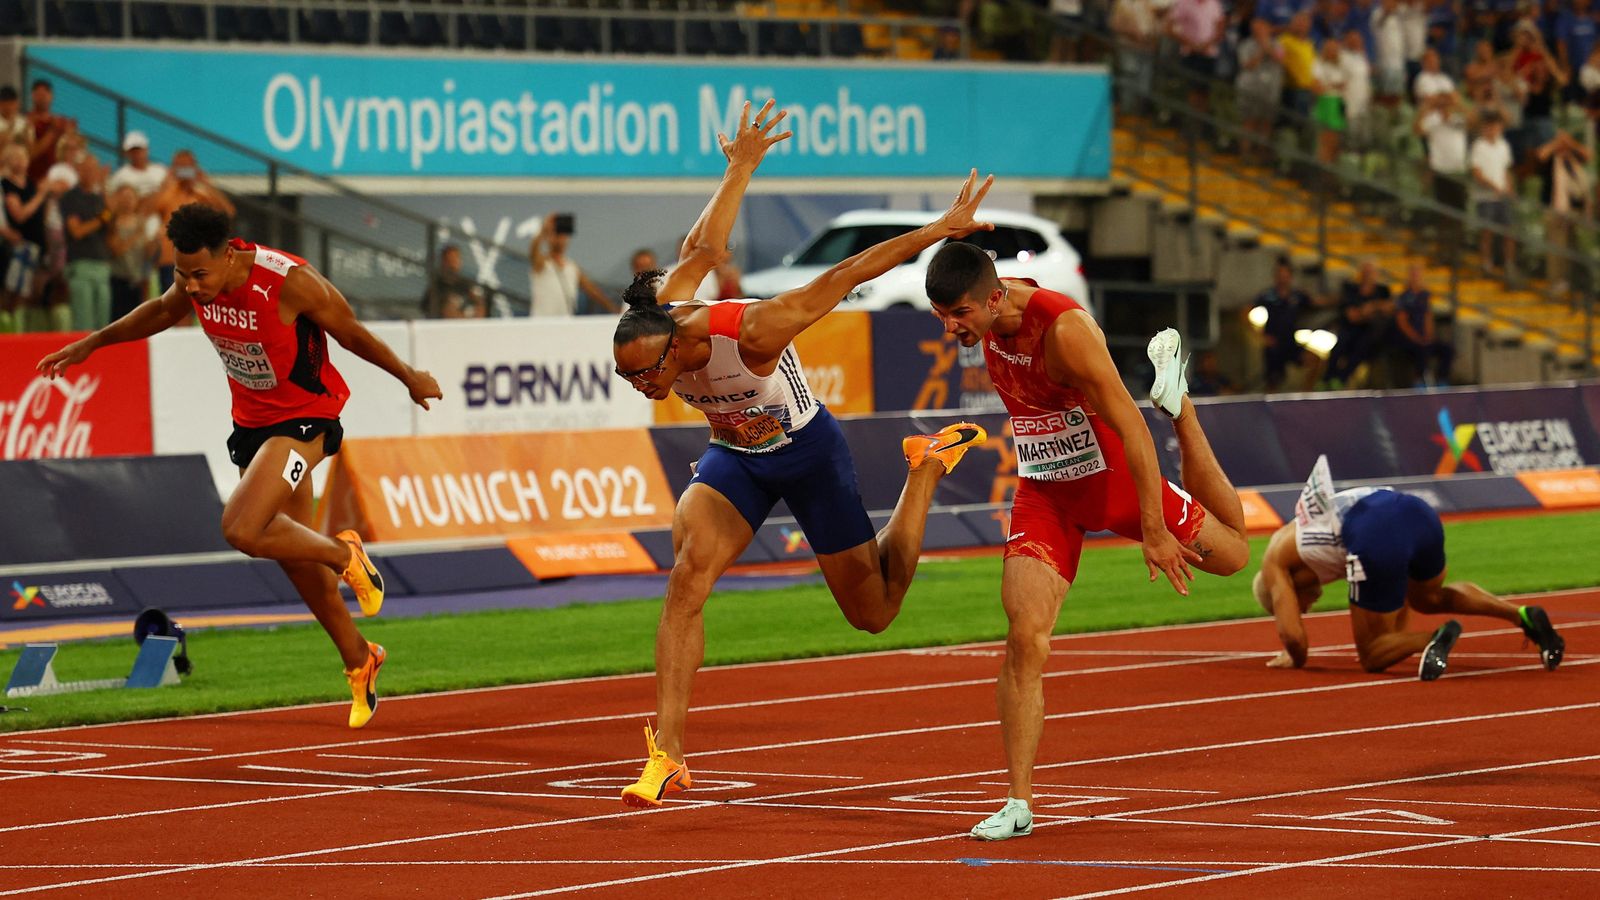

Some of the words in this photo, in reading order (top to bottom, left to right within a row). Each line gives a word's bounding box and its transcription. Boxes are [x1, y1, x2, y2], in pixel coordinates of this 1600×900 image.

[263, 72, 680, 170] Olympiastadion
[203, 303, 258, 331] SUISSE
[217, 351, 270, 373] OSEPH
[462, 361, 612, 408] BORNAN
[674, 389, 759, 404] FRANCE
[1013, 417, 1064, 434] SPAR
[1017, 430, 1095, 463] MARTÍNEZ
[290, 460, 303, 483] 8
[1041, 463, 1057, 472] RUN
[1071, 460, 1101, 477] 2022
[379, 470, 549, 528] MUNICH
[551, 465, 656, 519] 2022
